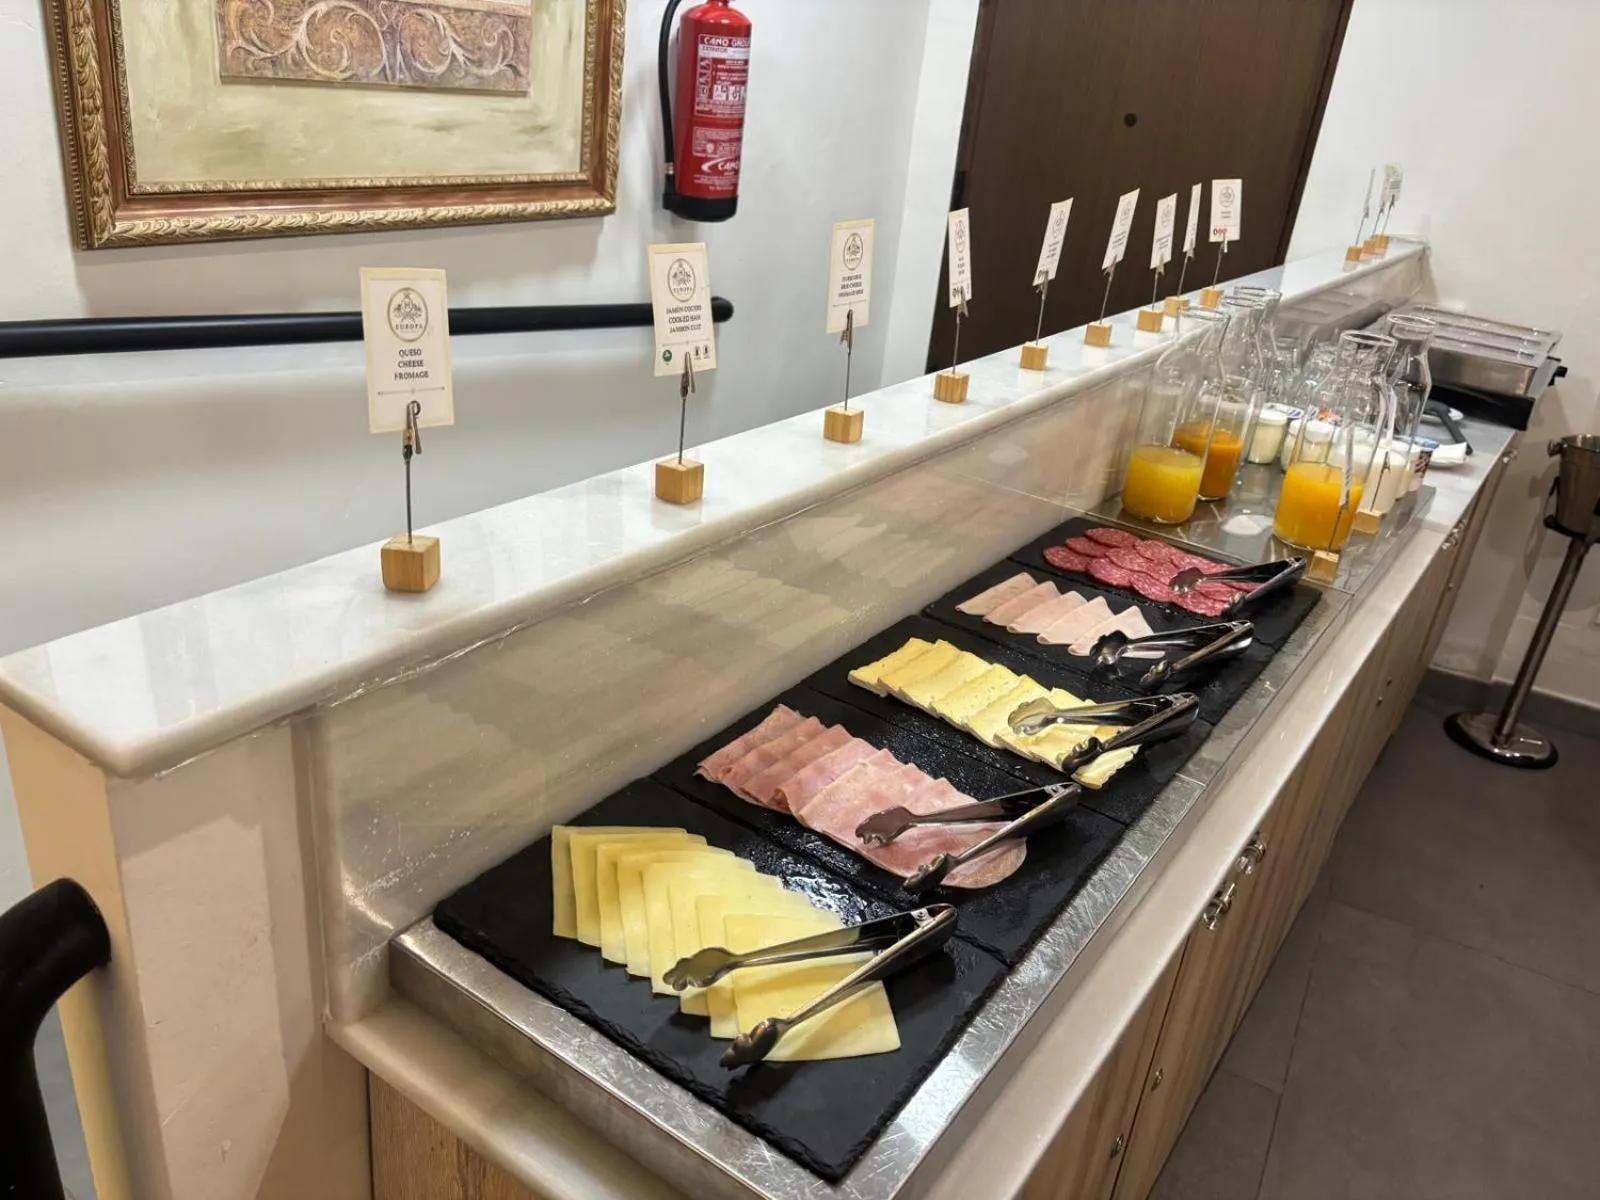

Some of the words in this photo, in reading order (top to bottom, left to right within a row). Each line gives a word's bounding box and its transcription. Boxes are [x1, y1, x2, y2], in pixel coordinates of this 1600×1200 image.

[704, 37, 729, 47] CANO
[668, 315, 689, 324] COOKED
[398, 349, 422, 358] QUESO
[397, 360, 424, 368] CHEESE
[394, 370, 429, 381] FROMAGE
